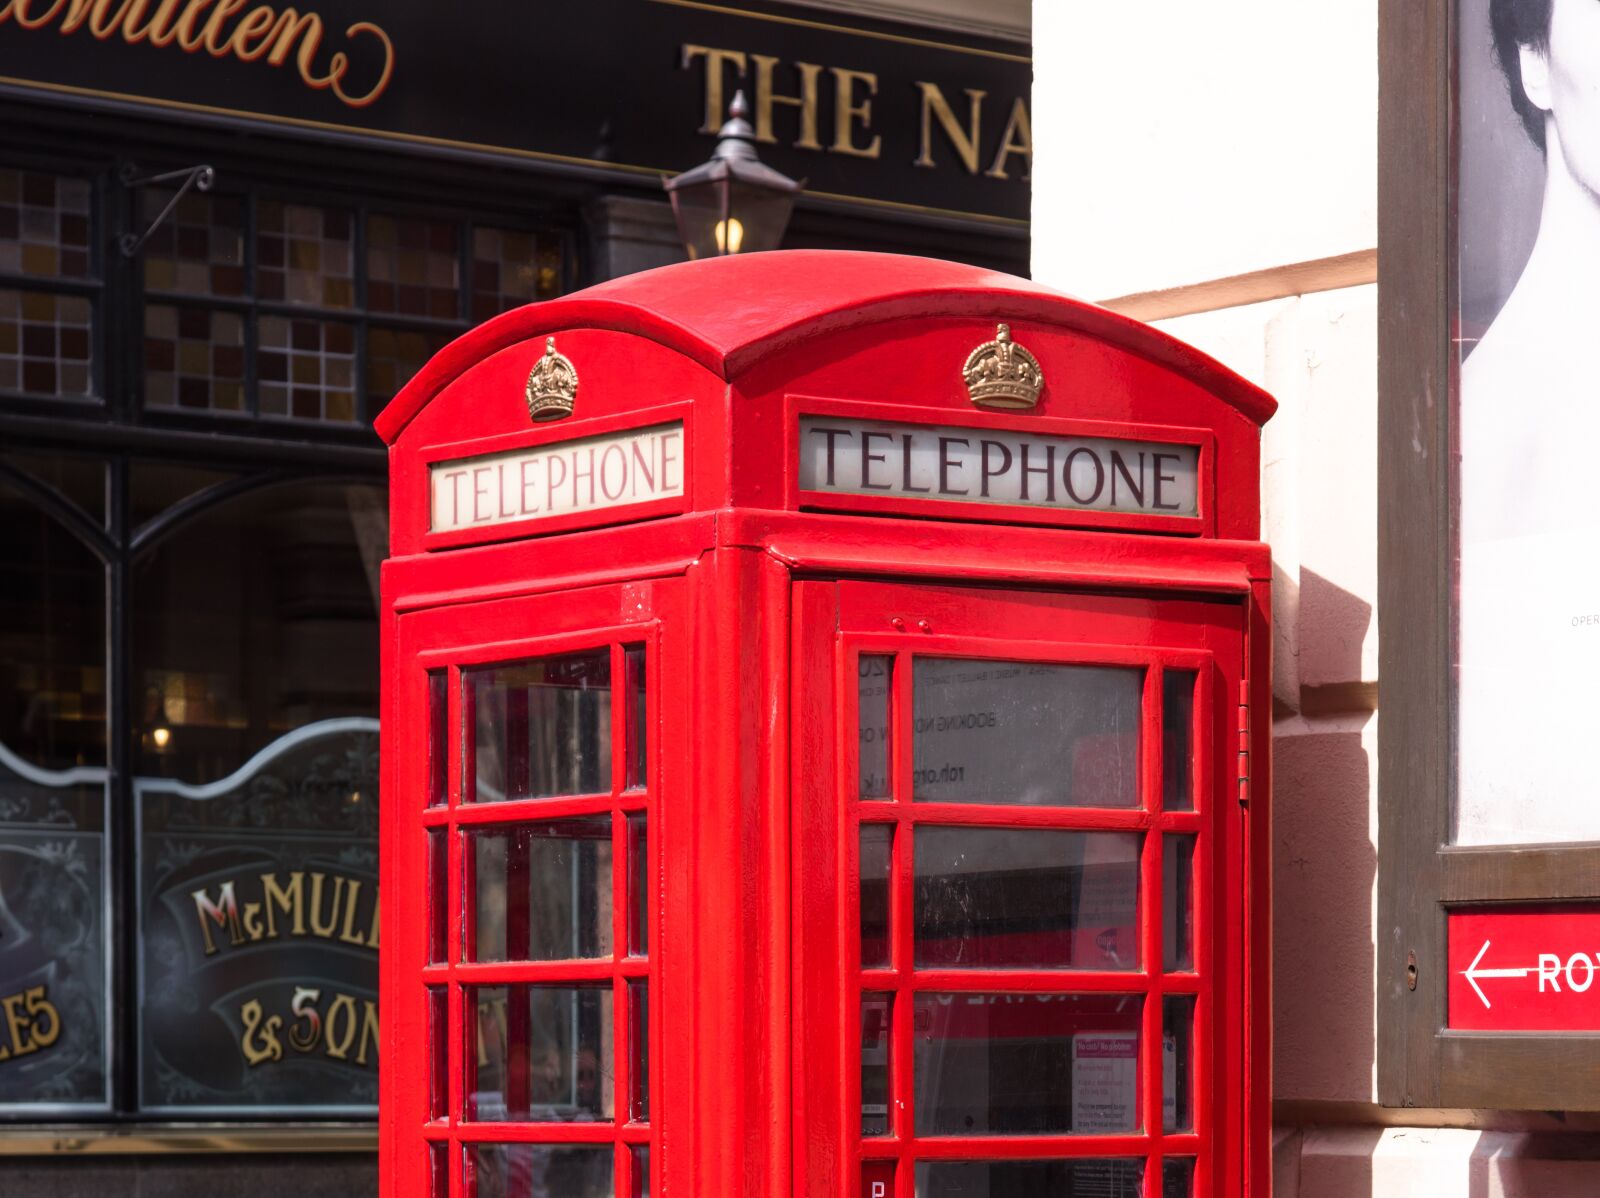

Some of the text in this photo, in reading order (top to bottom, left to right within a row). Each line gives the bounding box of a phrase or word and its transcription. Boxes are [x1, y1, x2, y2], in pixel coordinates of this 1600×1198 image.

[681, 43, 882, 160] THE
[444, 431, 681, 526] TELEPHONE
[808, 427, 1182, 511] TELEPHONE
[1538, 951, 1600, 993] RO
[0, 984, 61, 1060] ES
[241, 999, 283, 1066] &
